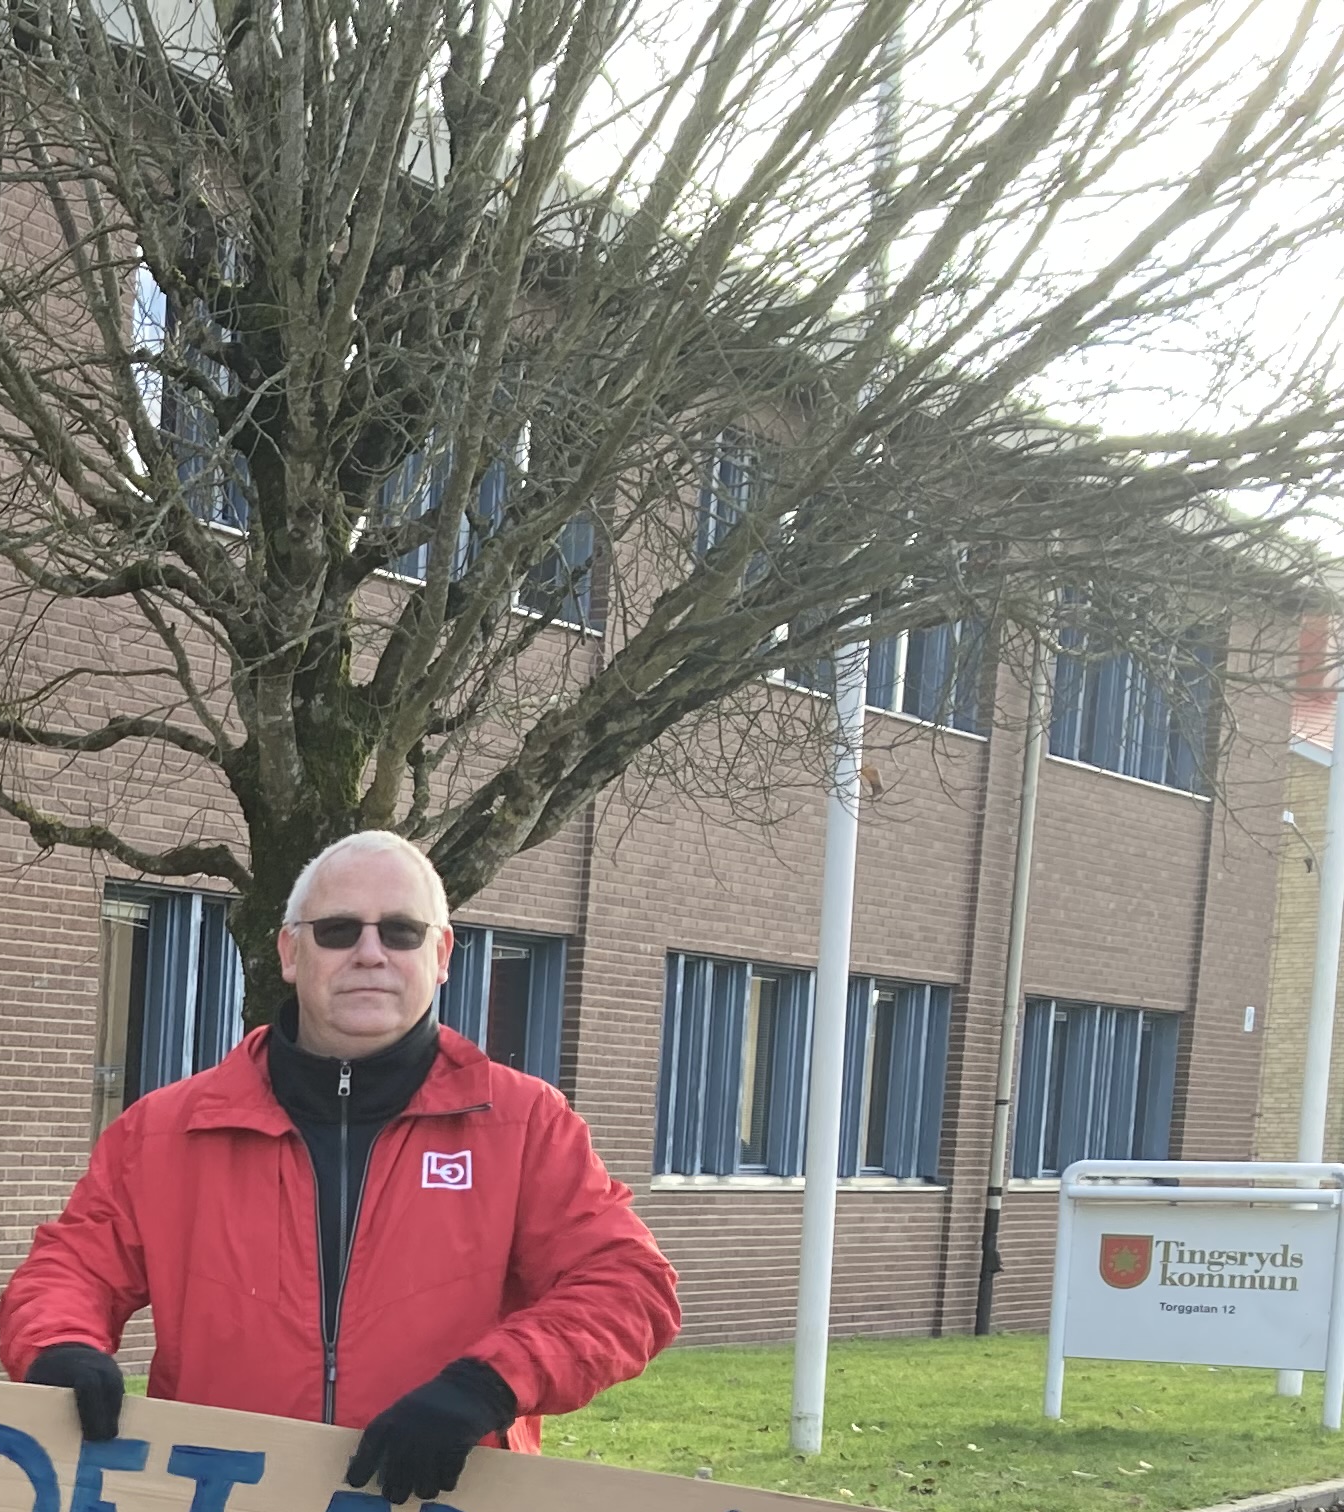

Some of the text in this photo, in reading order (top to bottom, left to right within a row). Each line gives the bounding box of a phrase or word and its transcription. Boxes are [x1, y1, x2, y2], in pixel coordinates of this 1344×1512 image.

[1155, 1239, 1303, 1274] Tingsryds
[1158, 1262, 1299, 1292] kommun
[1159, 1302, 1236, 1315] Torggatan 12
